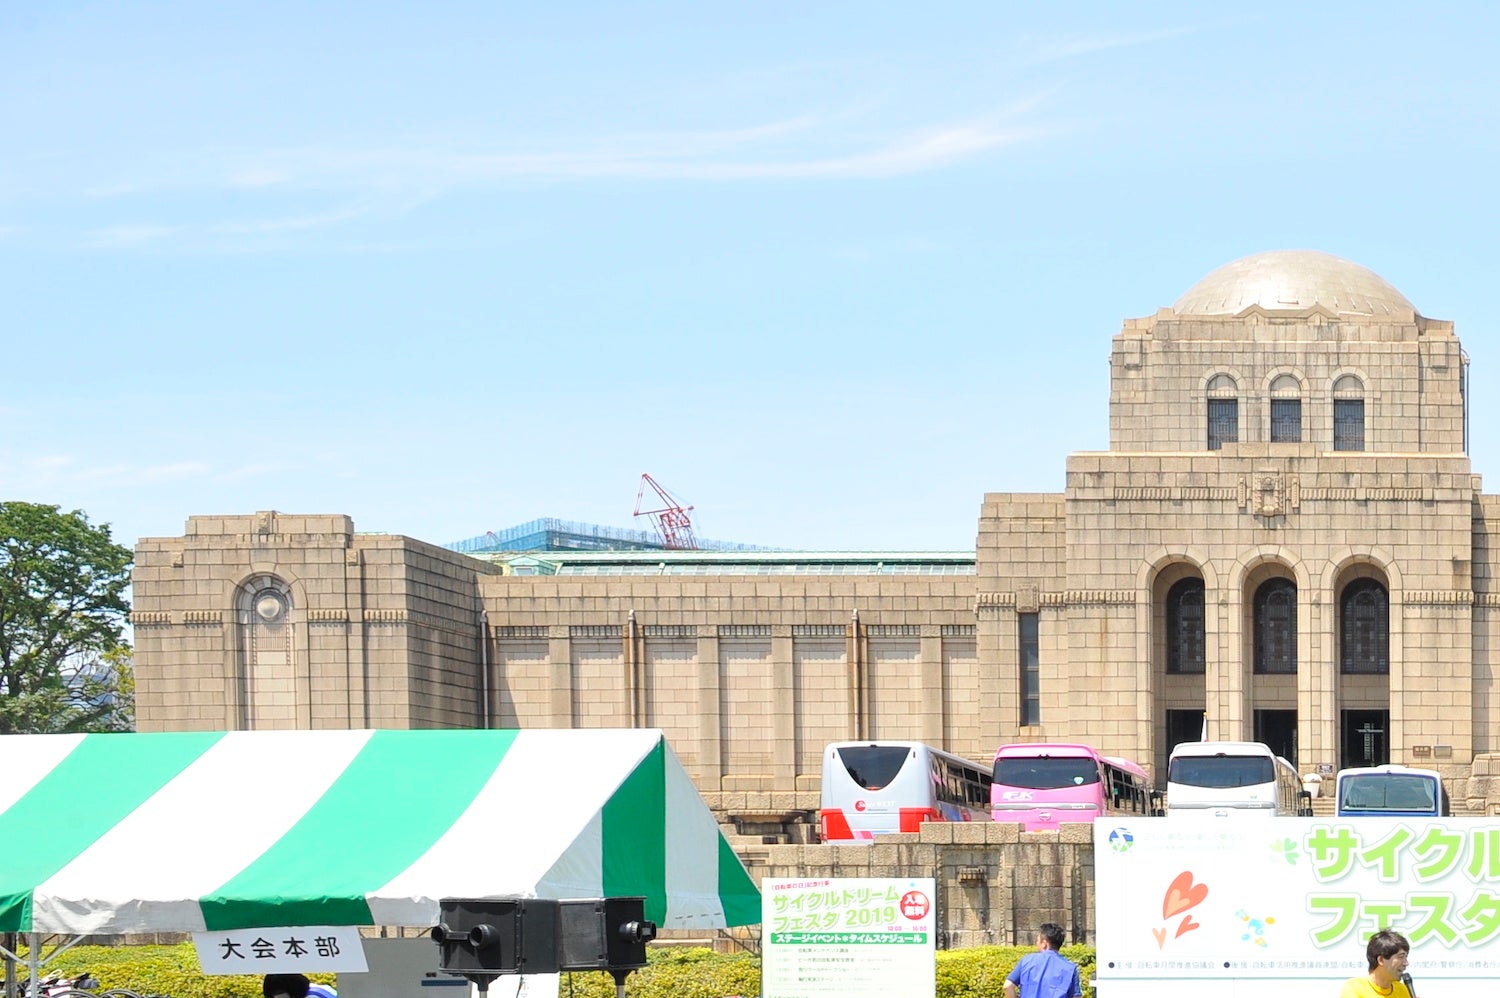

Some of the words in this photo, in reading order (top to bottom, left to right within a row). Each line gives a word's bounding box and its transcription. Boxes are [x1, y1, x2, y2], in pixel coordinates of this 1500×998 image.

[772, 884, 901, 912] サイクルドリーム
[772, 910, 839, 933] フェスタ
[845, 905, 897, 927] 2019
[219, 936, 341, 960] 大会本部
